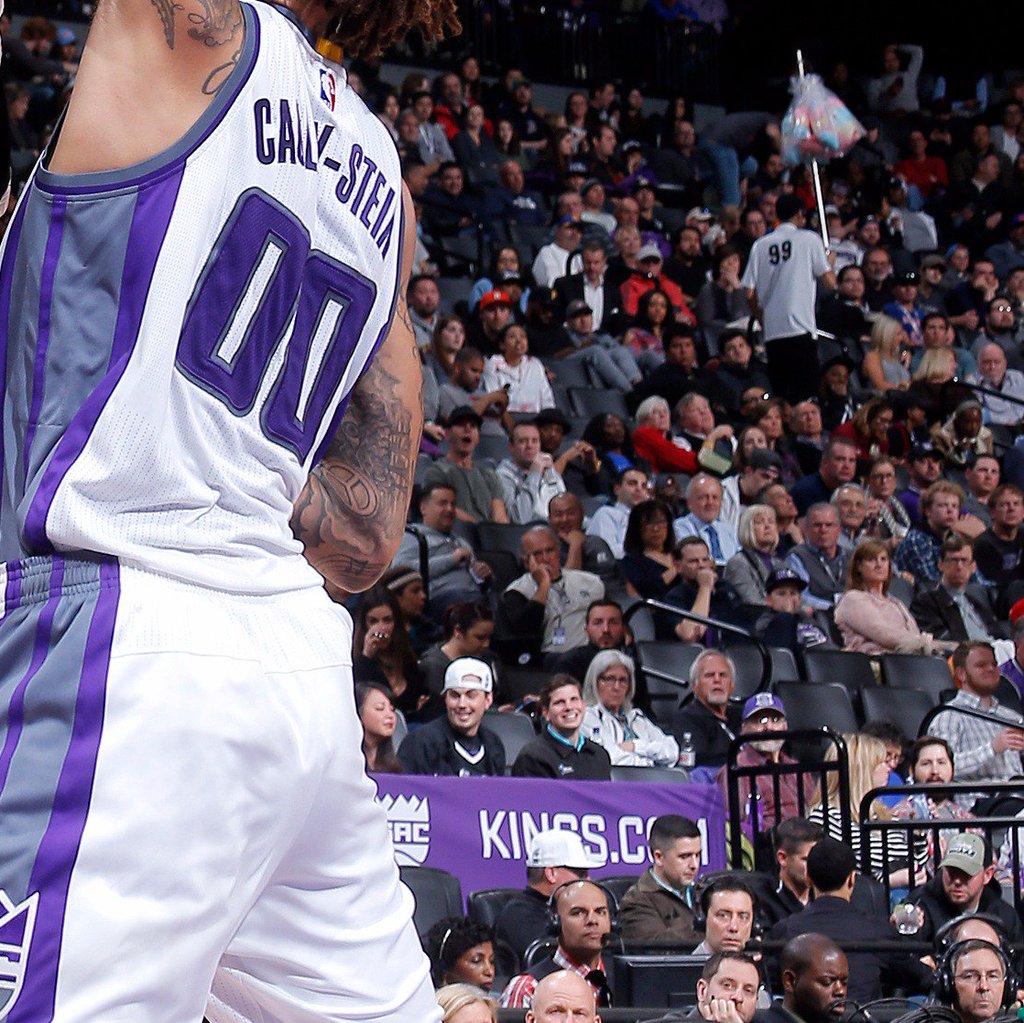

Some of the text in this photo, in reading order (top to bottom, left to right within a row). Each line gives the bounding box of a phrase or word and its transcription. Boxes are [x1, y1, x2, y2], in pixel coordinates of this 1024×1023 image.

[768, 240, 793, 266] 99
[175, 186, 378, 467] 00
[388, 821, 431, 844] AC
[478, 808, 709, 866] KINS.C
